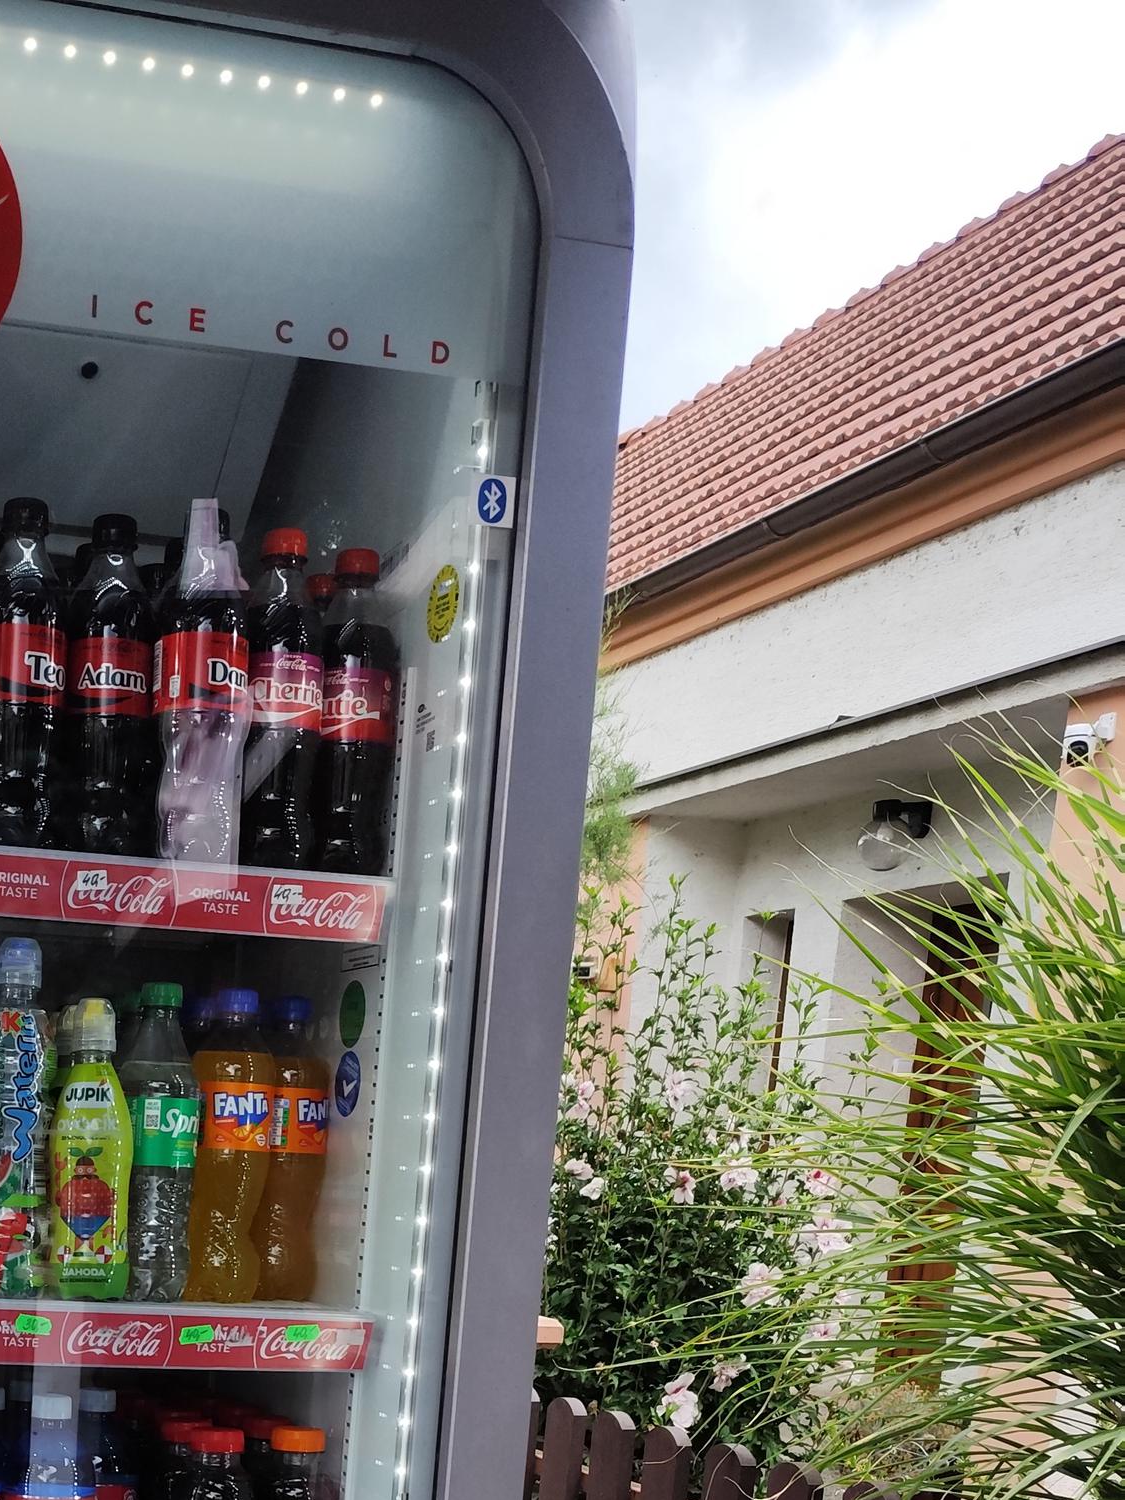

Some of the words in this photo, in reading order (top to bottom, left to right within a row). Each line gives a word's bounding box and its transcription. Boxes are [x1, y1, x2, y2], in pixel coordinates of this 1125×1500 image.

[89, 293, 206, 334] ICE
[275, 319, 450, 366] COLD
[25, 651, 66, 692] Teo
[78, 662, 147, 694] Adam
[321, 689, 369, 718] utie
[0, 885, 38, 900] TASTE
[189, 886, 251, 903] ORIGINAL
[202, 900, 240, 915] TASTE
[213, 1091, 269, 1117] FANTA
[298, 1098, 329, 1122] FAN
[160, 1107, 200, 1139] Spri
[62, 1267, 107, 1277] JAHODA
[2, 1335, 40, 1347] TASTE
[67, 1320, 168, 1358] Coca-Cola
[195, 1342, 231, 1353] TASTE
